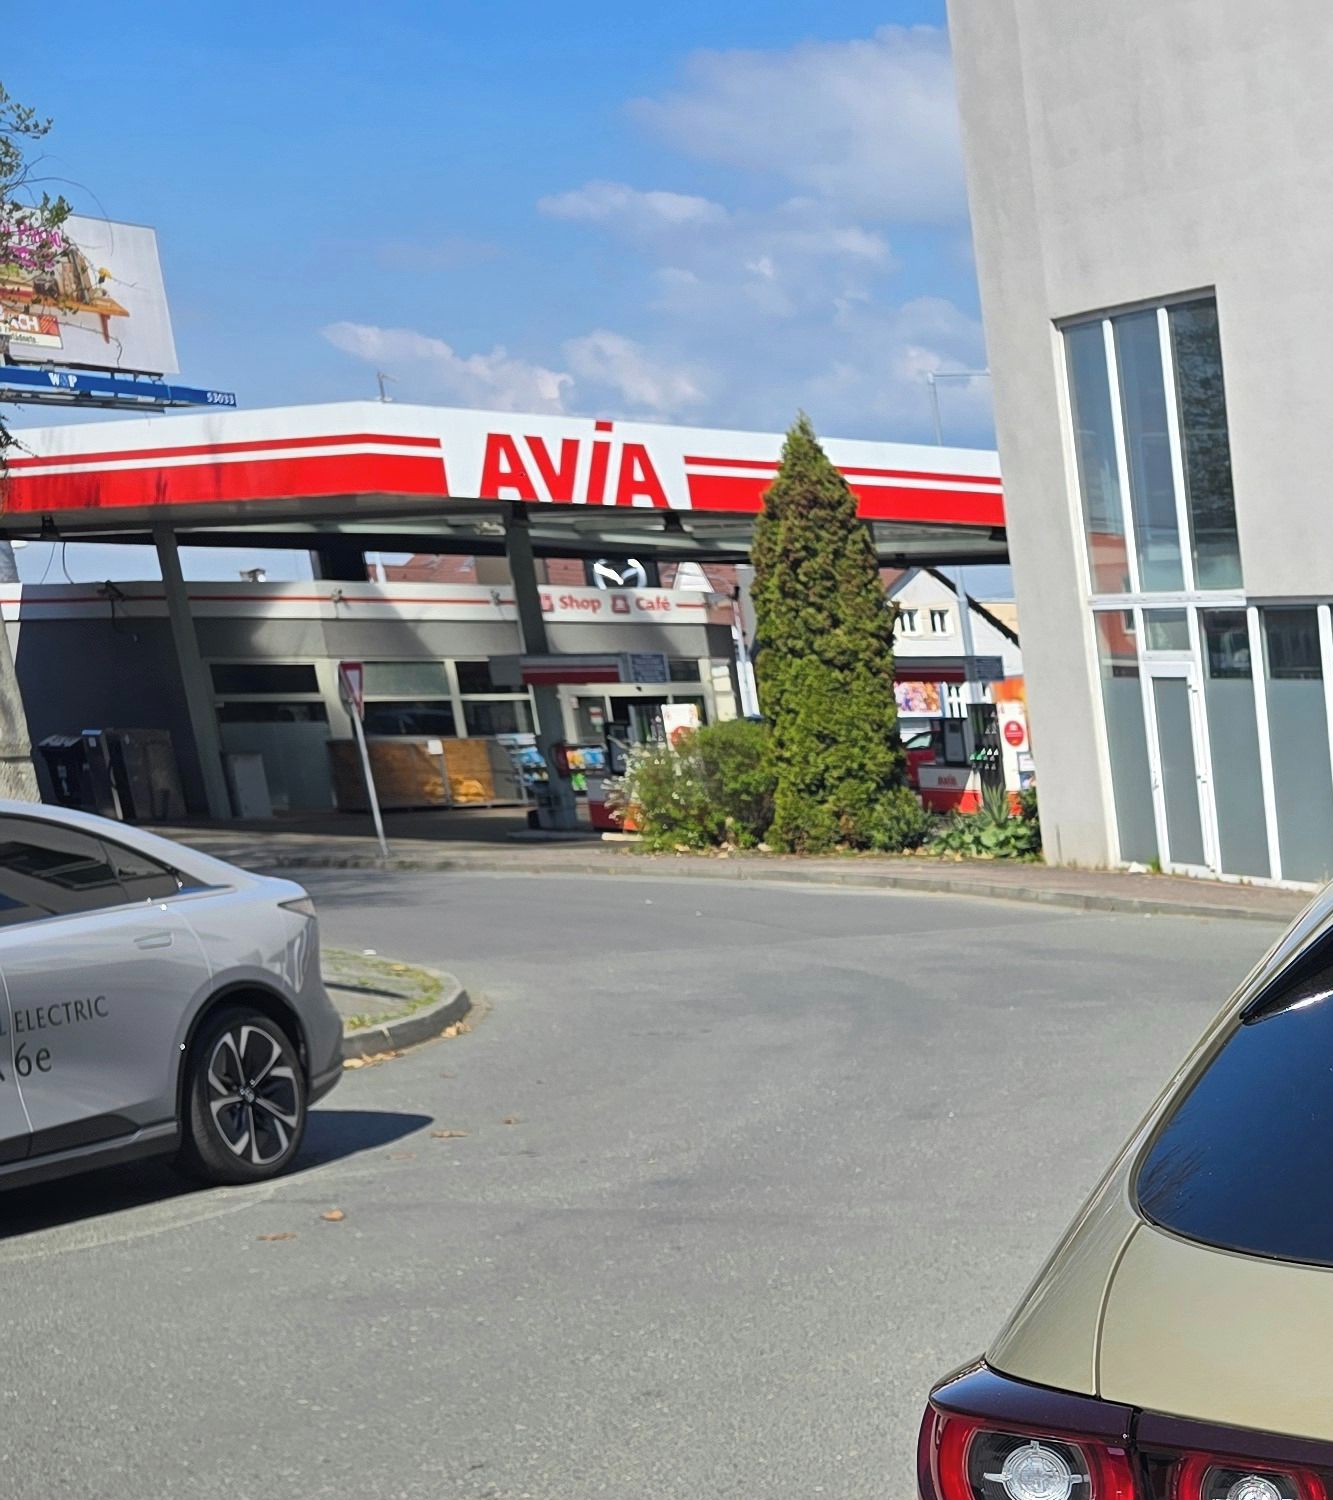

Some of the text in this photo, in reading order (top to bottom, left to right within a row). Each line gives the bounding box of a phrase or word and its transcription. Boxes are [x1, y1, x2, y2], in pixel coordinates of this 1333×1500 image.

[558, 595, 671, 613] Shop Café
[14, 996, 109, 1033] ELECTRIC
[14, 1041, 52, 1077] 6e
